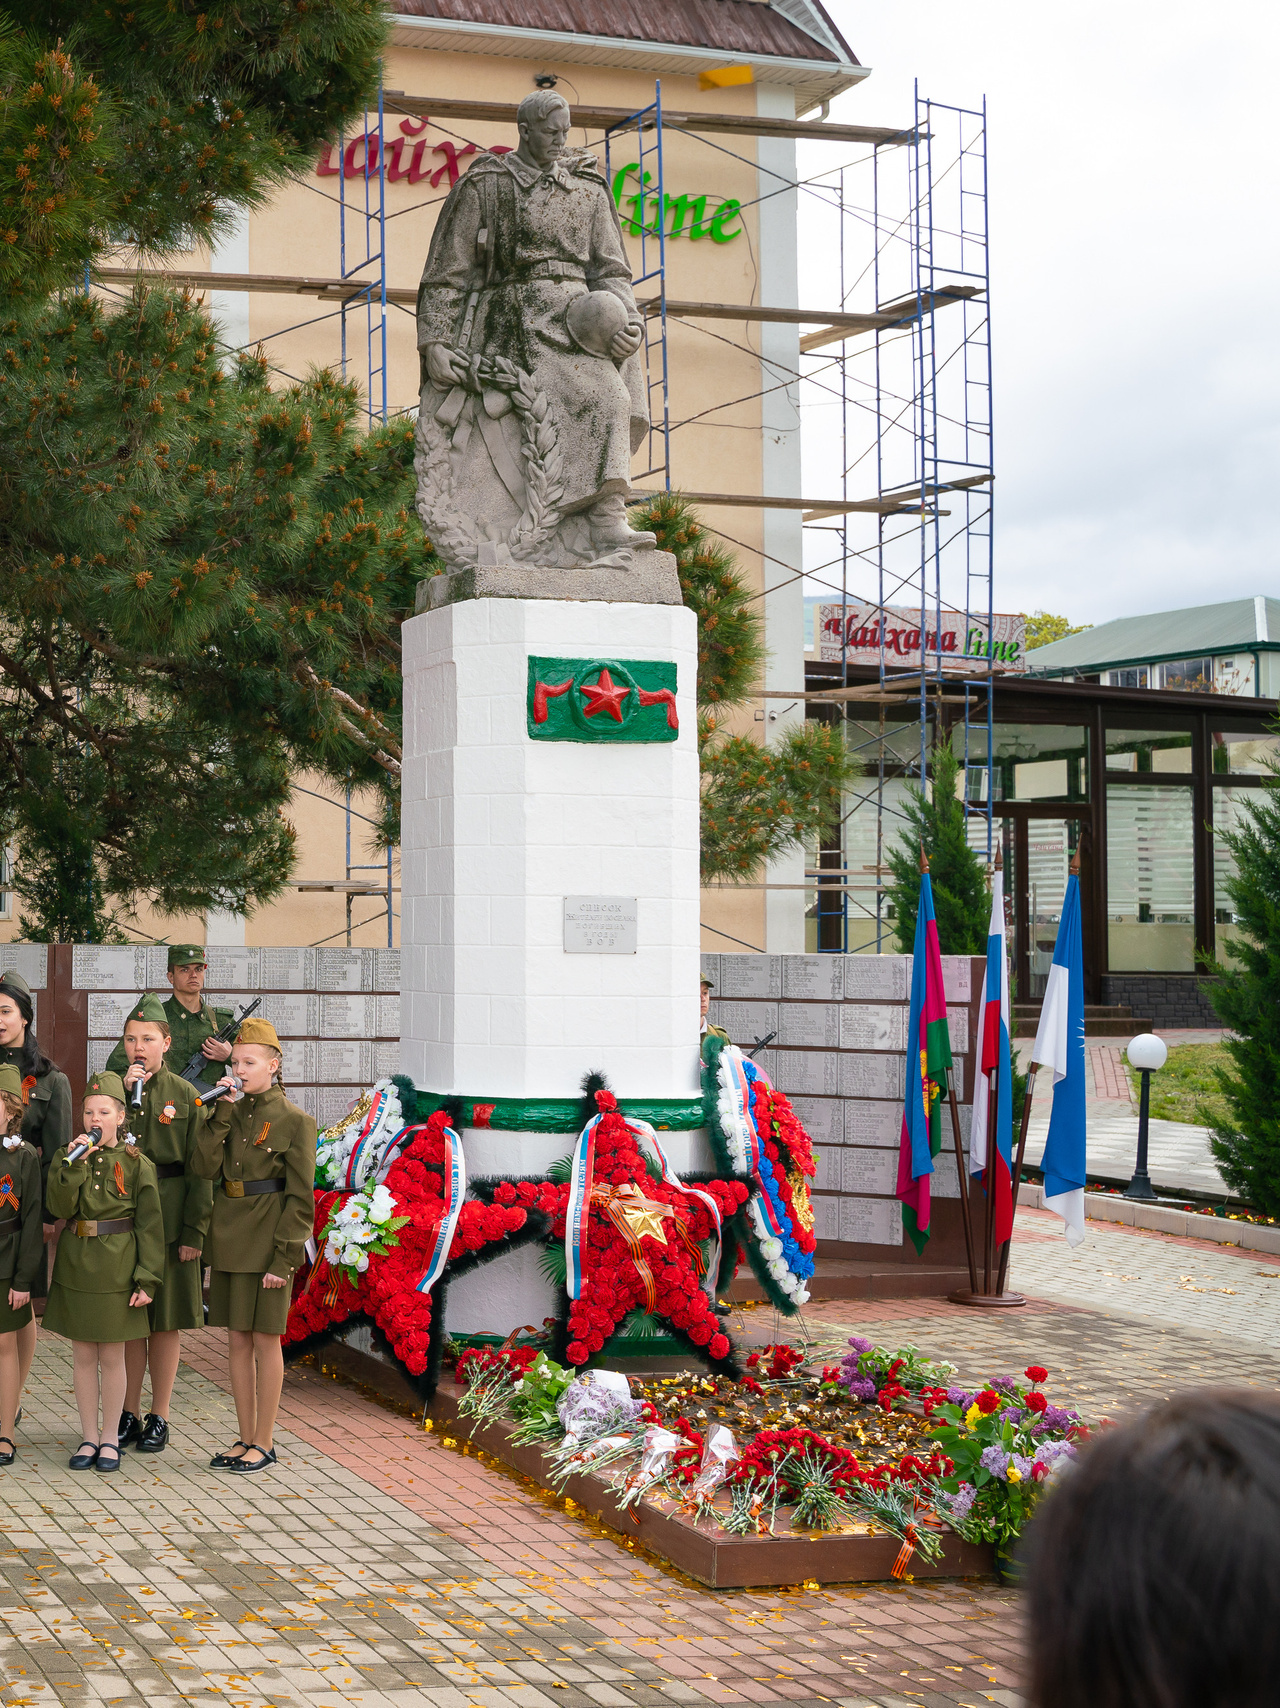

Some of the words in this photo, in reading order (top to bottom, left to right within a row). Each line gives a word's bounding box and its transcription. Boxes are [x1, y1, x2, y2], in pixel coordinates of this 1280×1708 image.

[612, 162, 742, 244] lime
[824, 613, 958, 656] Чайхана
[963, 628, 1020, 662] lime
